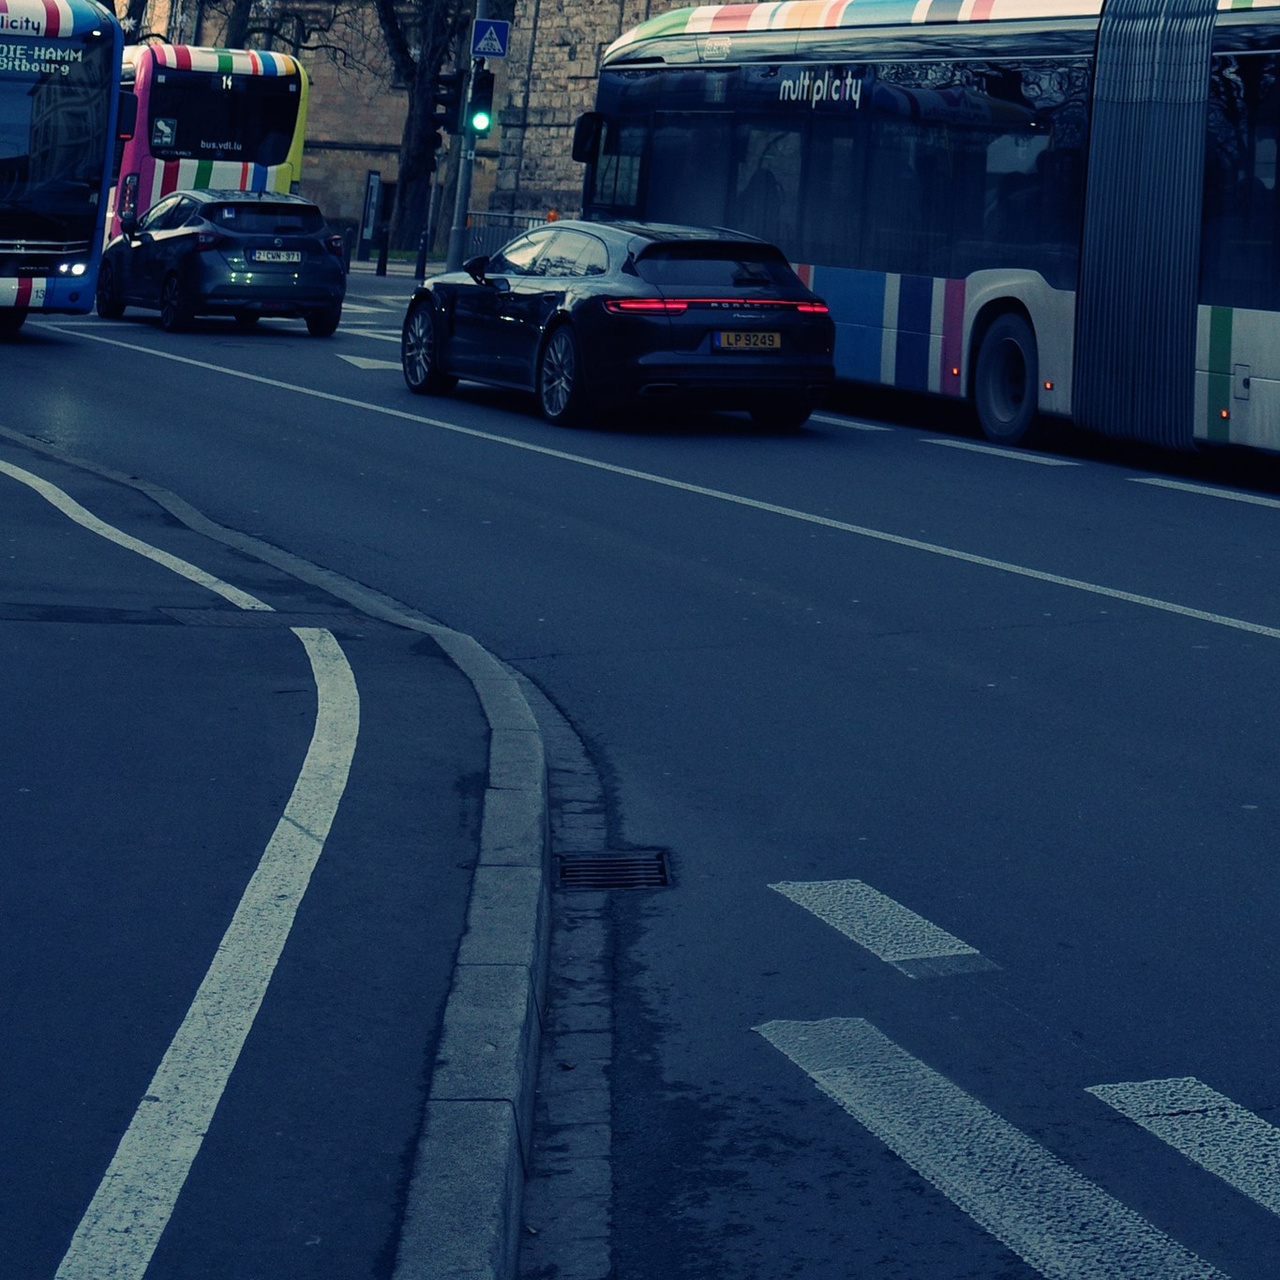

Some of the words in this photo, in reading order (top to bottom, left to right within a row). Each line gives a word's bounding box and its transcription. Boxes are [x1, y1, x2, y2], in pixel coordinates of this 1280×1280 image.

[221, 75, 233, 90] 14
[779, 70, 862, 110] multiplicity
[200, 140, 243, 151] bus.vdl.lu
[727, 334, 742, 347] LP
[744, 334, 775, 347] 9249
